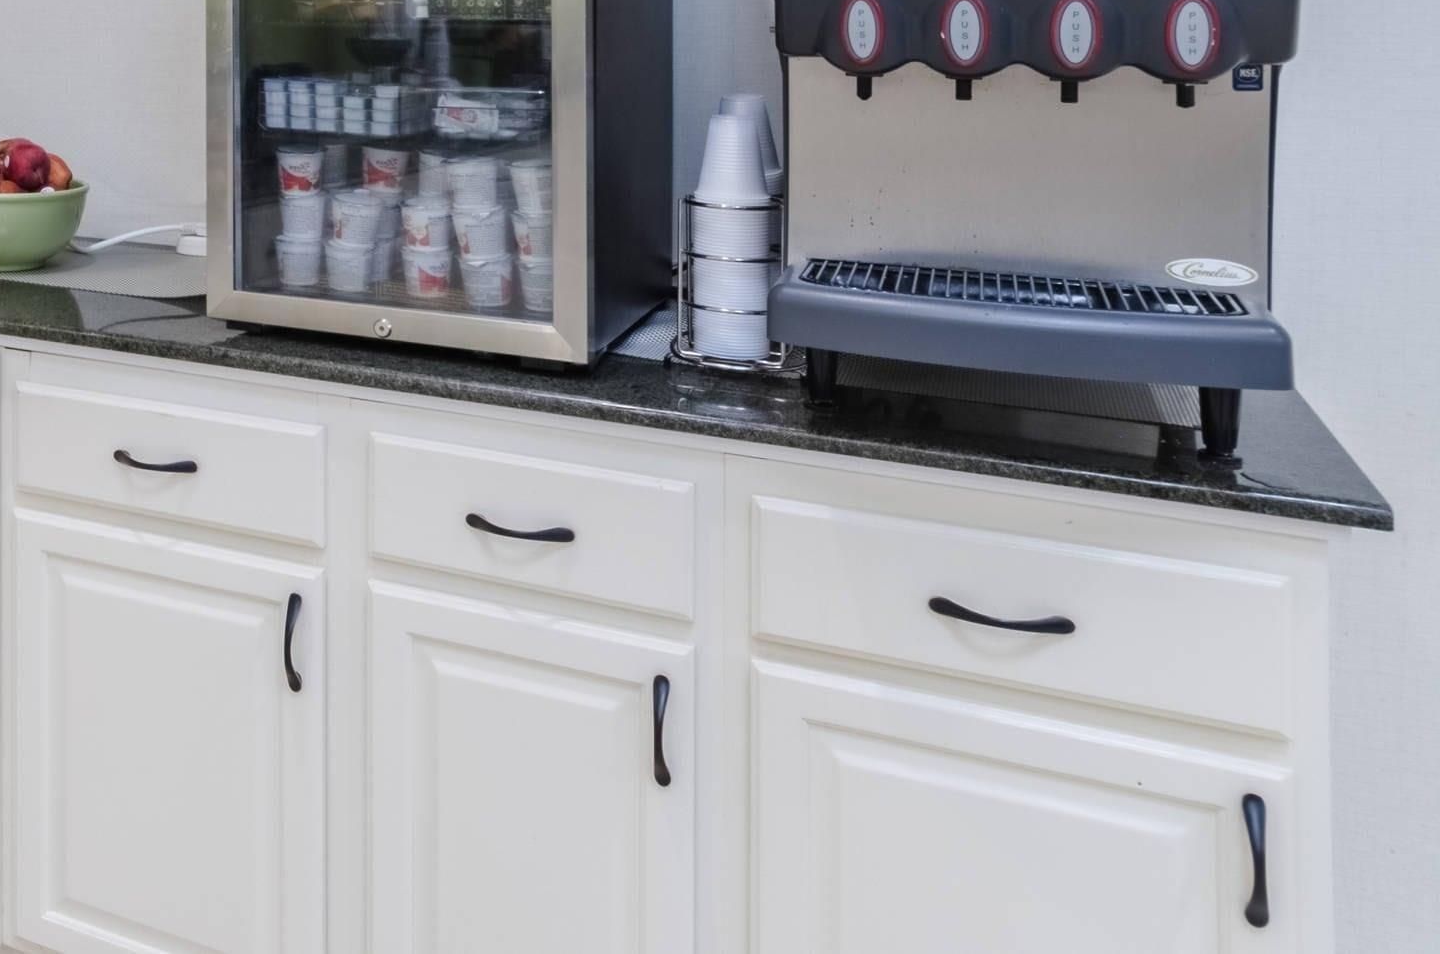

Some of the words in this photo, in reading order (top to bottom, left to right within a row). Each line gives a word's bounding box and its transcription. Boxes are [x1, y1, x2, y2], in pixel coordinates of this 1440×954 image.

[858, 9, 866, 49] PUSH
[961, 9, 969, 51] PUSH
[1072, 11, 1080, 54] PUSH
[1188, 12, 1197, 55] PUSH
